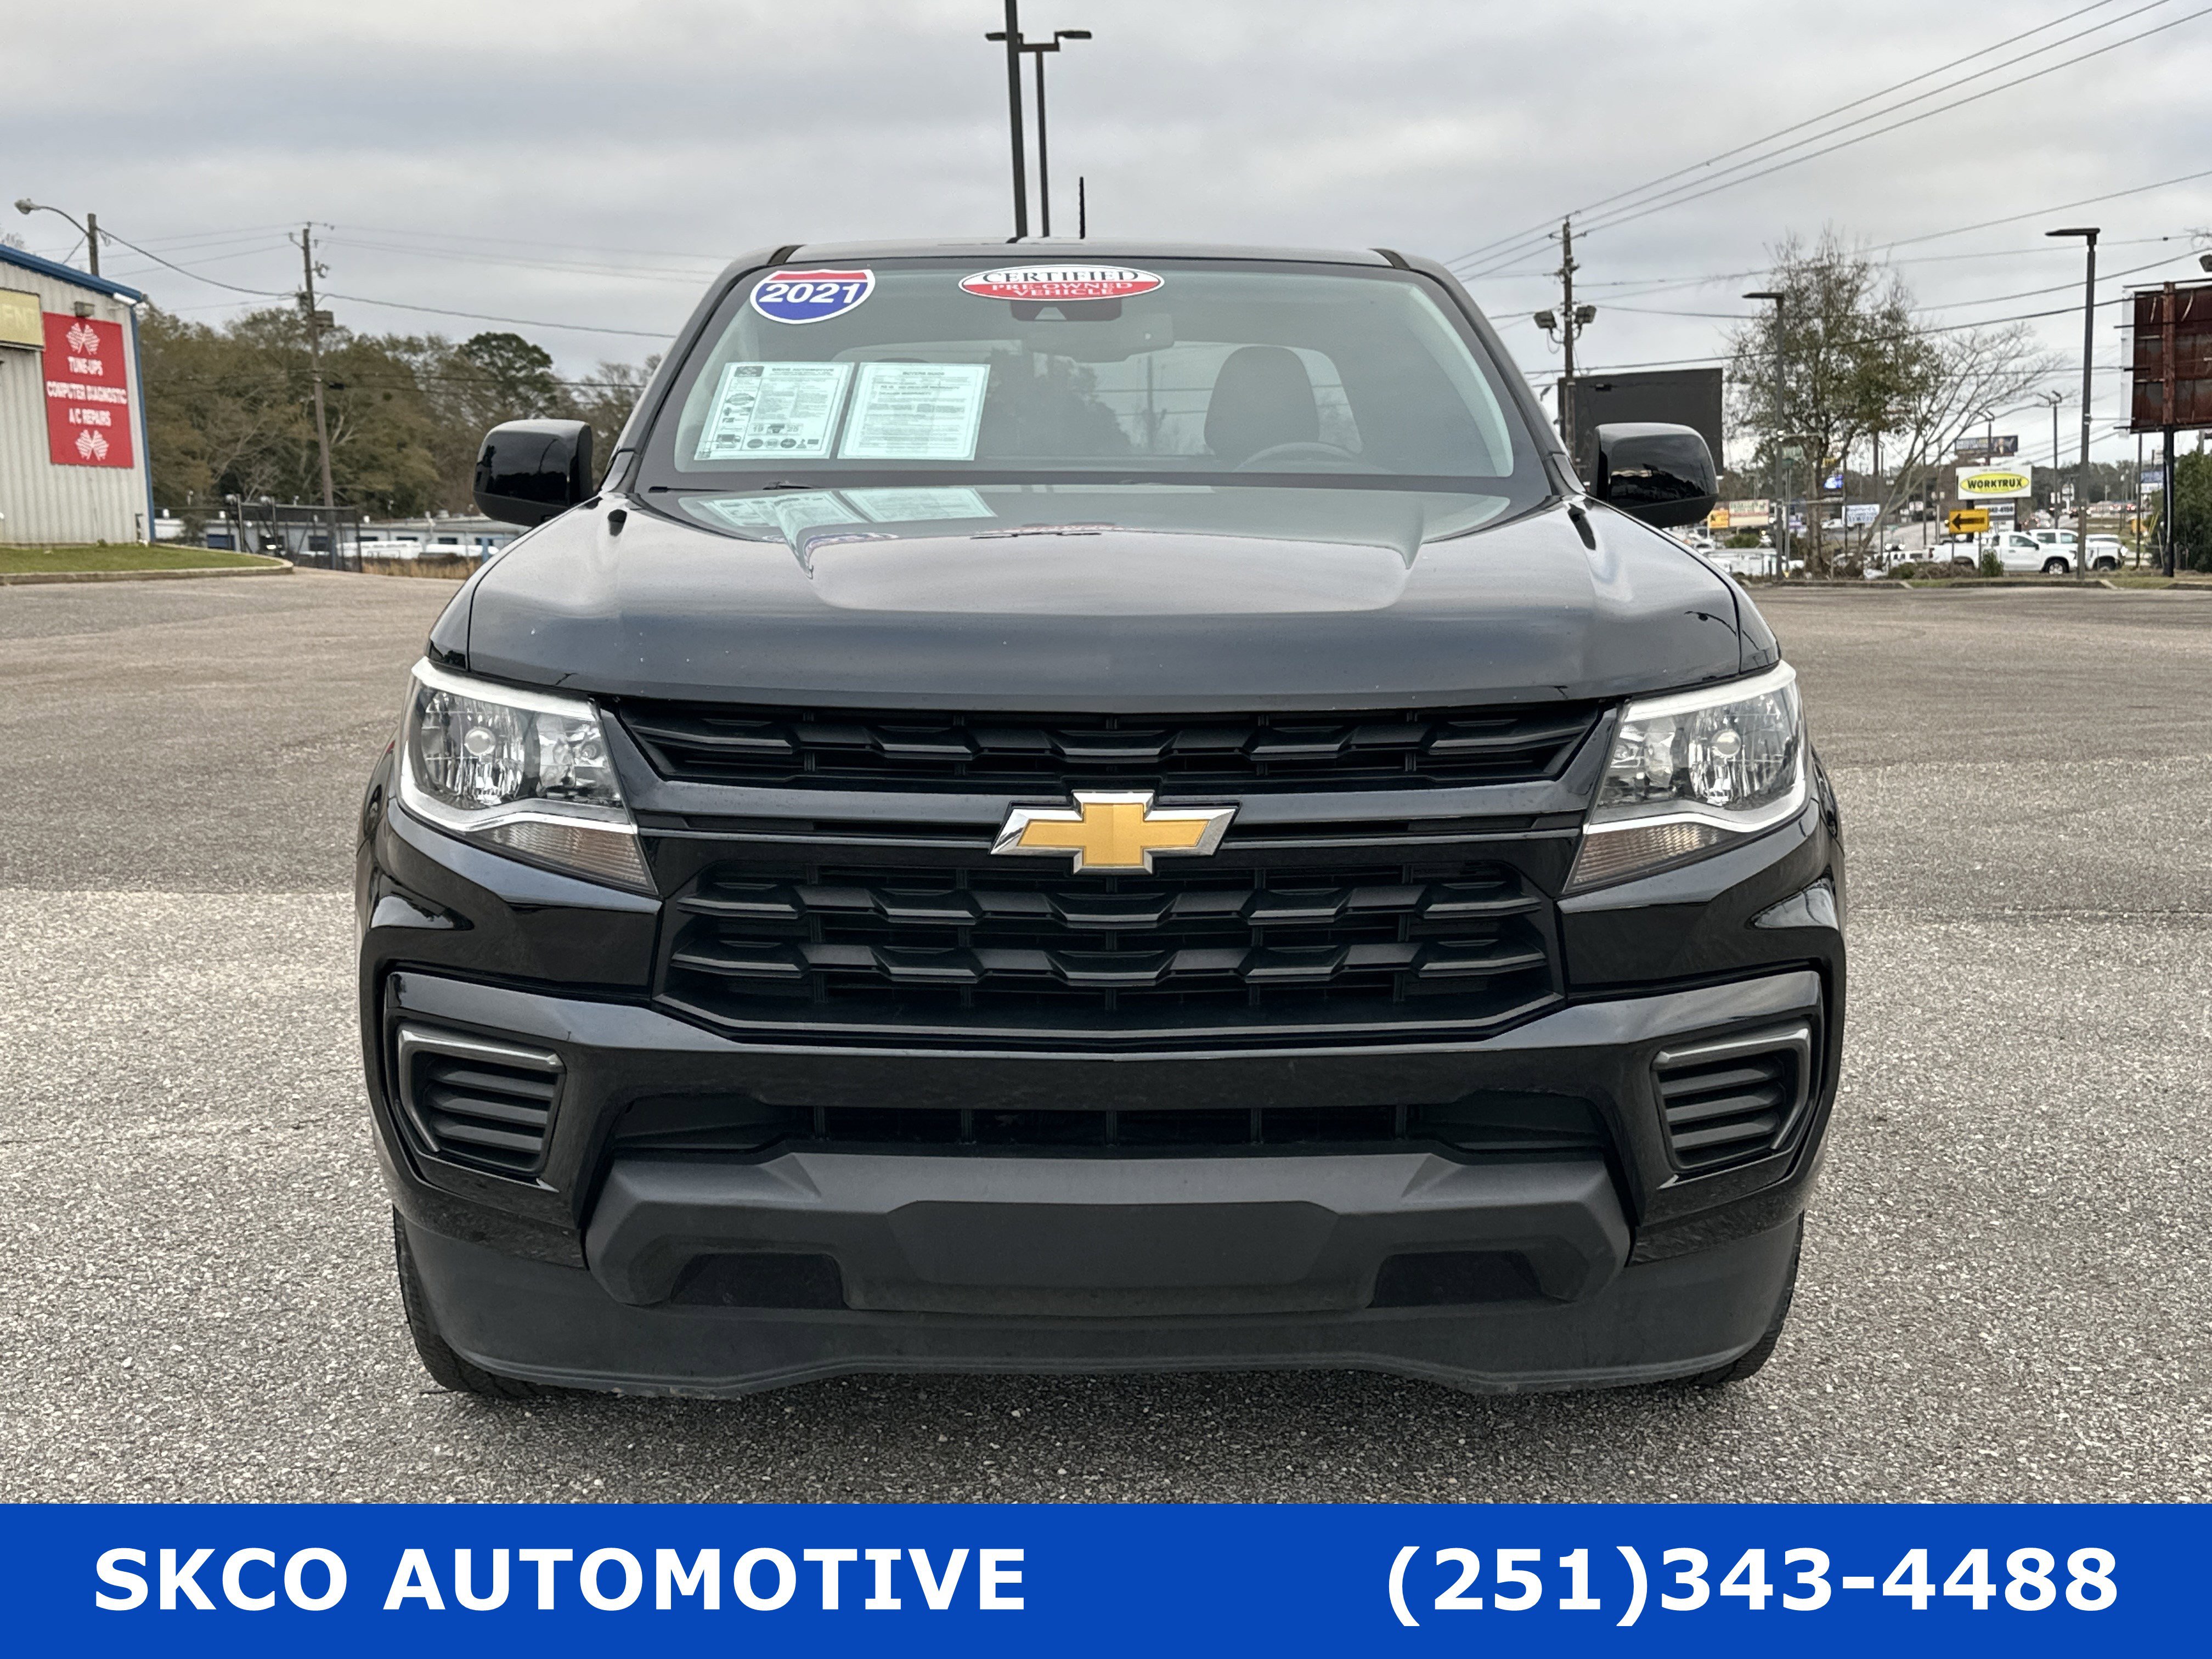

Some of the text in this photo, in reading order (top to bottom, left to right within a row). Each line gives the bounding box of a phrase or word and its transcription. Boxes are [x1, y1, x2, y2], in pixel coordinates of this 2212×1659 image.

[983, 271, 1138, 283] CERTIFIED
[992, 282, 1133, 290] PRE-OWNED
[759, 283, 860, 303] 2021
[1013, 288, 1114, 296] VEHICLE
[1967, 478, 2022, 489] WORKTRUX
